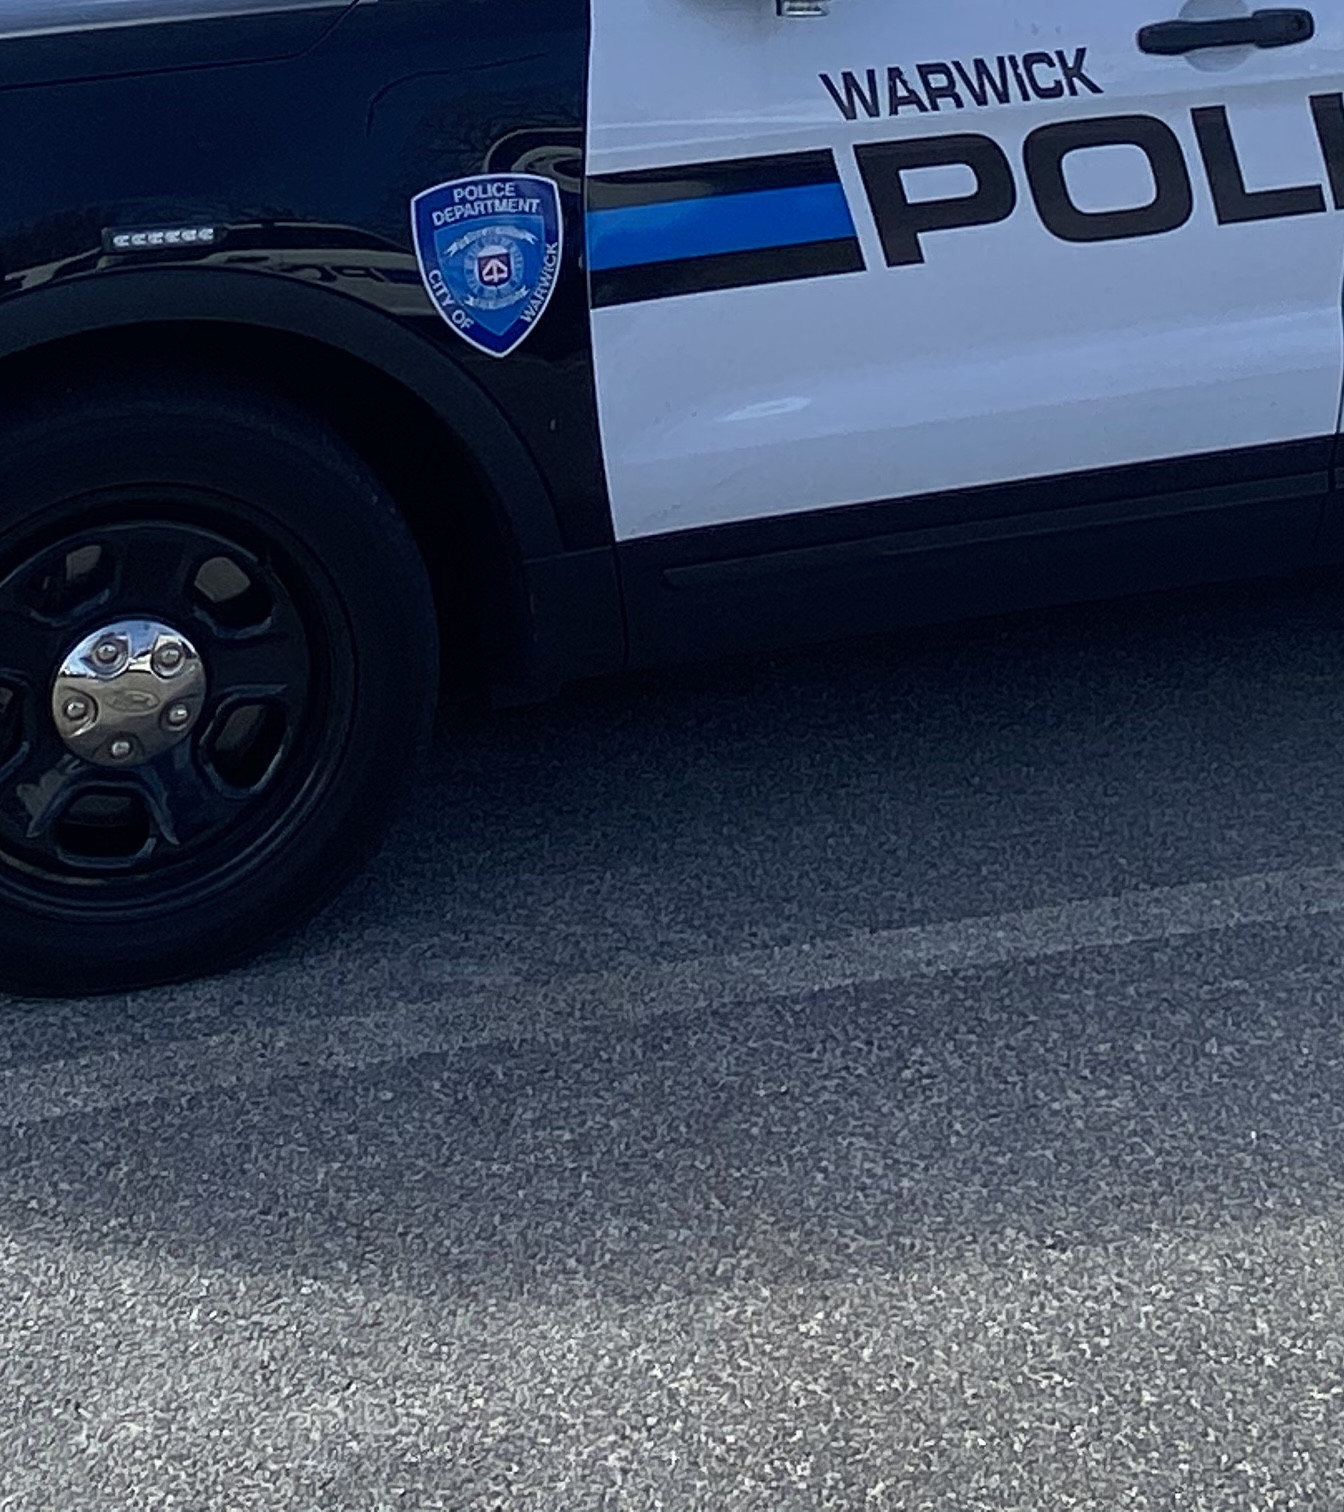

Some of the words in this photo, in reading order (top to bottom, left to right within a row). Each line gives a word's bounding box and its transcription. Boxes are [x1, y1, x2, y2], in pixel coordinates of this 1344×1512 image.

[819, 46, 1104, 120] WARWICK
[431, 198, 541, 226] DEPARTMENT
[453, 182, 516, 203] POLICE
[428, 269, 455, 307] CITY
[451, 308, 475, 330] OF
[520, 241, 558, 323] WARWICK
